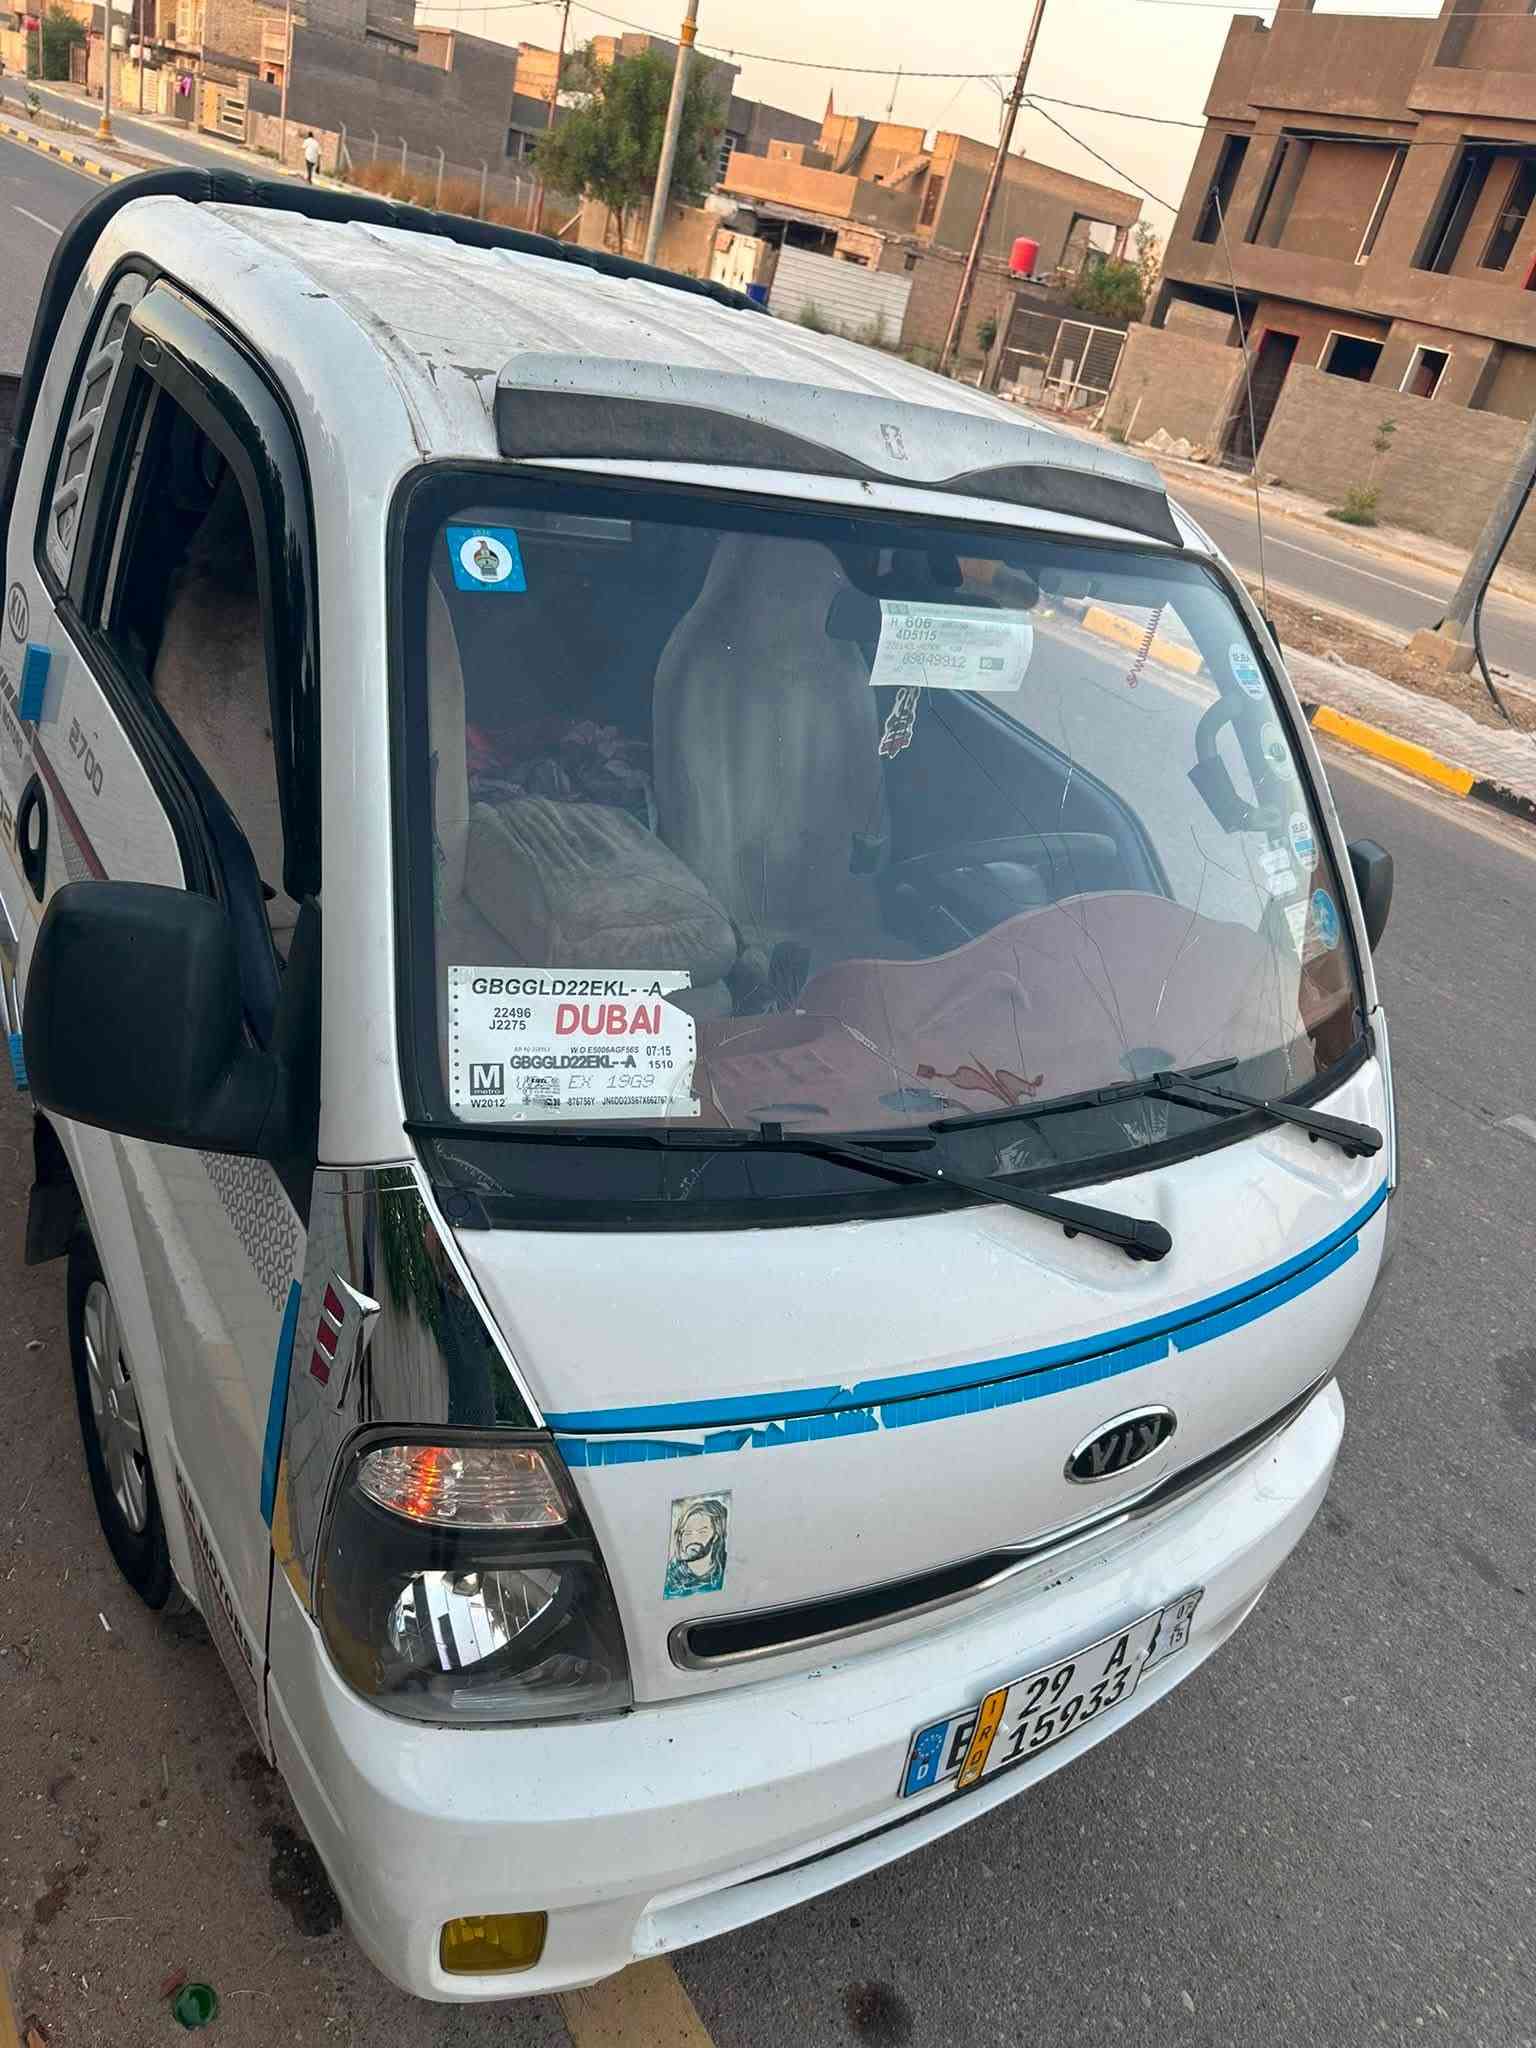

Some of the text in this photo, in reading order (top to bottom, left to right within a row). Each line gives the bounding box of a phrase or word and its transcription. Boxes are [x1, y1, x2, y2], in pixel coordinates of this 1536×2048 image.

[11, 590, 26, 637] KIA
[493, 1007, 532, 1019] 22496
[555, 1003, 662, 1035] DUBAI
[488, 1020, 527, 1031] J2275
[646, 1046, 672, 1057] 07:15
[649, 1060, 673, 1070] 1510
[475, 1065, 499, 1089] M
[471, 1099, 506, 1109] W2012
[1087, 1420, 1161, 1474] KIA
[1018, 1633, 1131, 1721] 29 A
[1001, 1664, 1133, 1764] 15933
[916, 1763, 930, 1781] D
